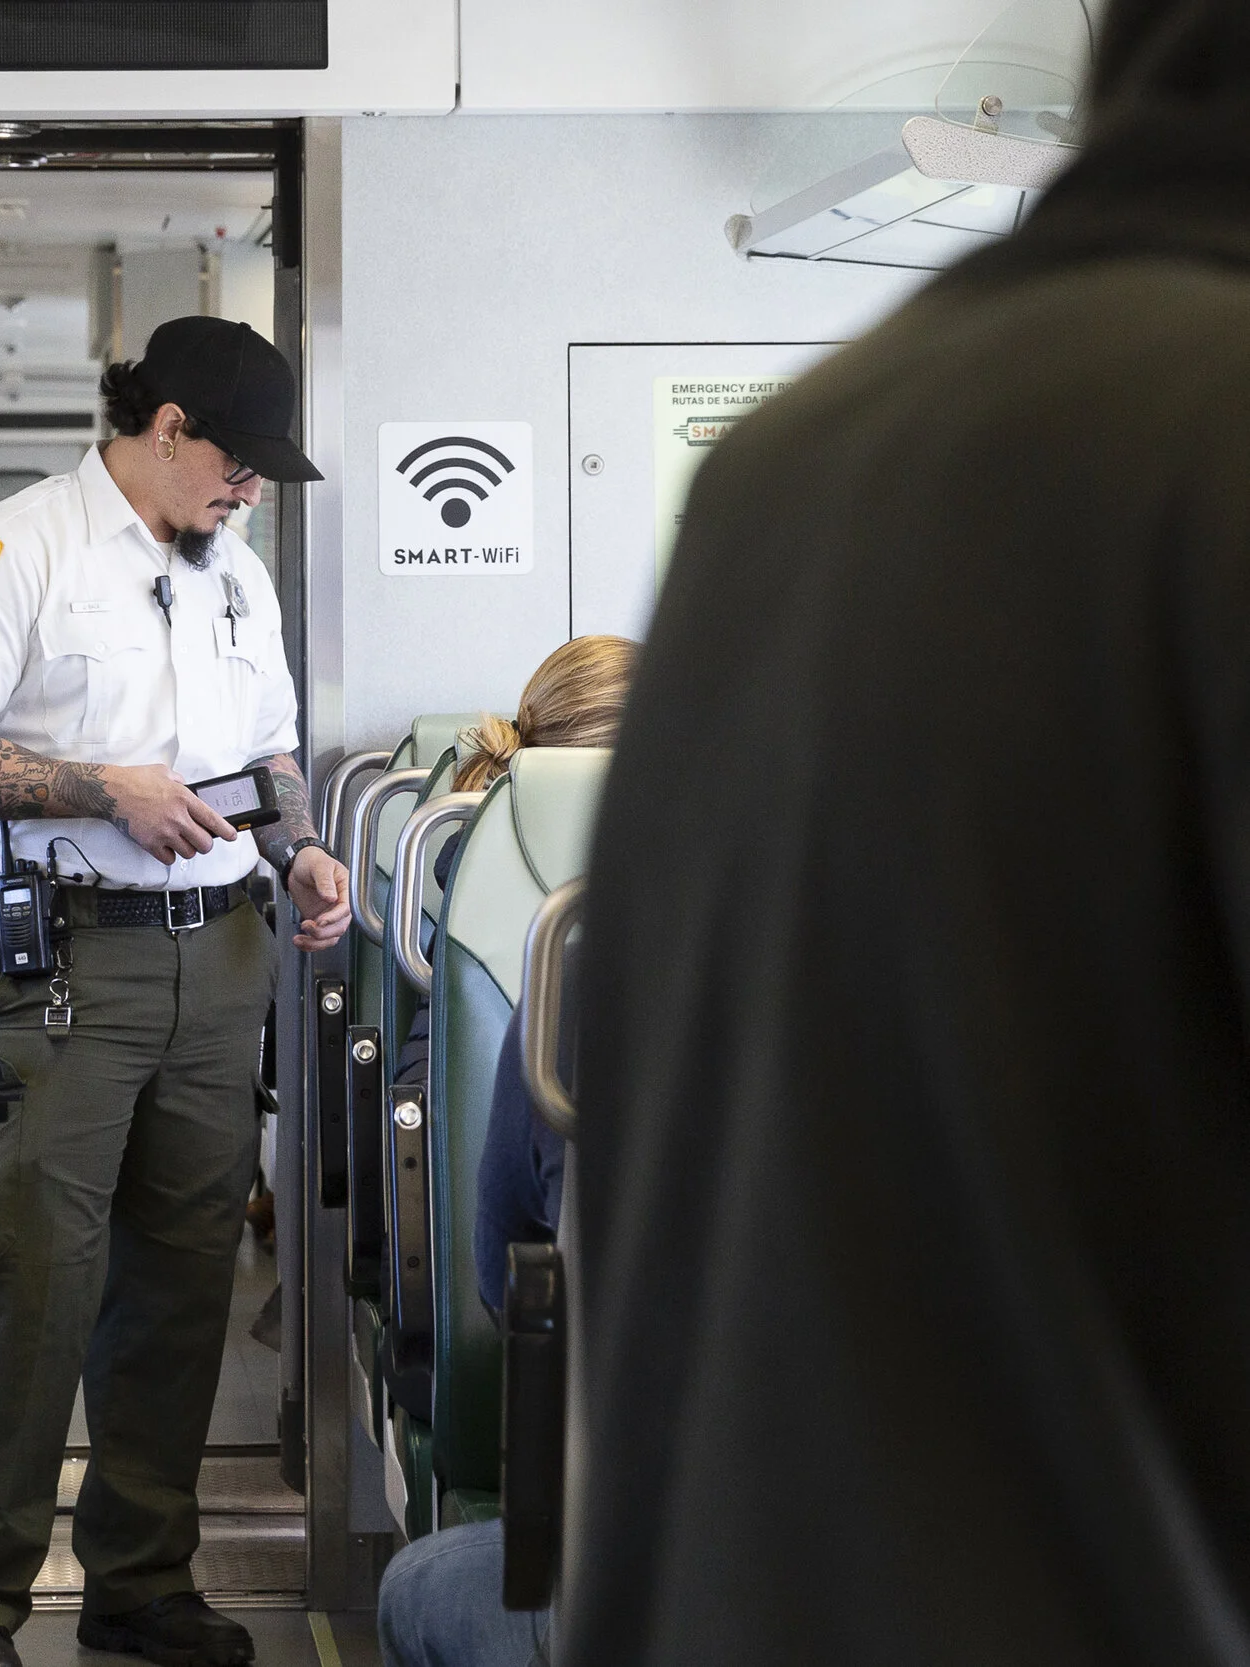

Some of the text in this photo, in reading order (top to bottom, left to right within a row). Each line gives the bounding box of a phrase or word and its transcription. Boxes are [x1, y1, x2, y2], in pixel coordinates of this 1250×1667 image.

[672, 384, 746, 393] EMERGENCY
[749, 383, 774, 393] EXIT
[672, 397, 705, 405] RUTAS
[707, 396, 720, 405] DE
[723, 396, 759, 405] SALIDA
[394, 547, 519, 564] SMART-WiFi
[230, 789, 244, 807] YES
